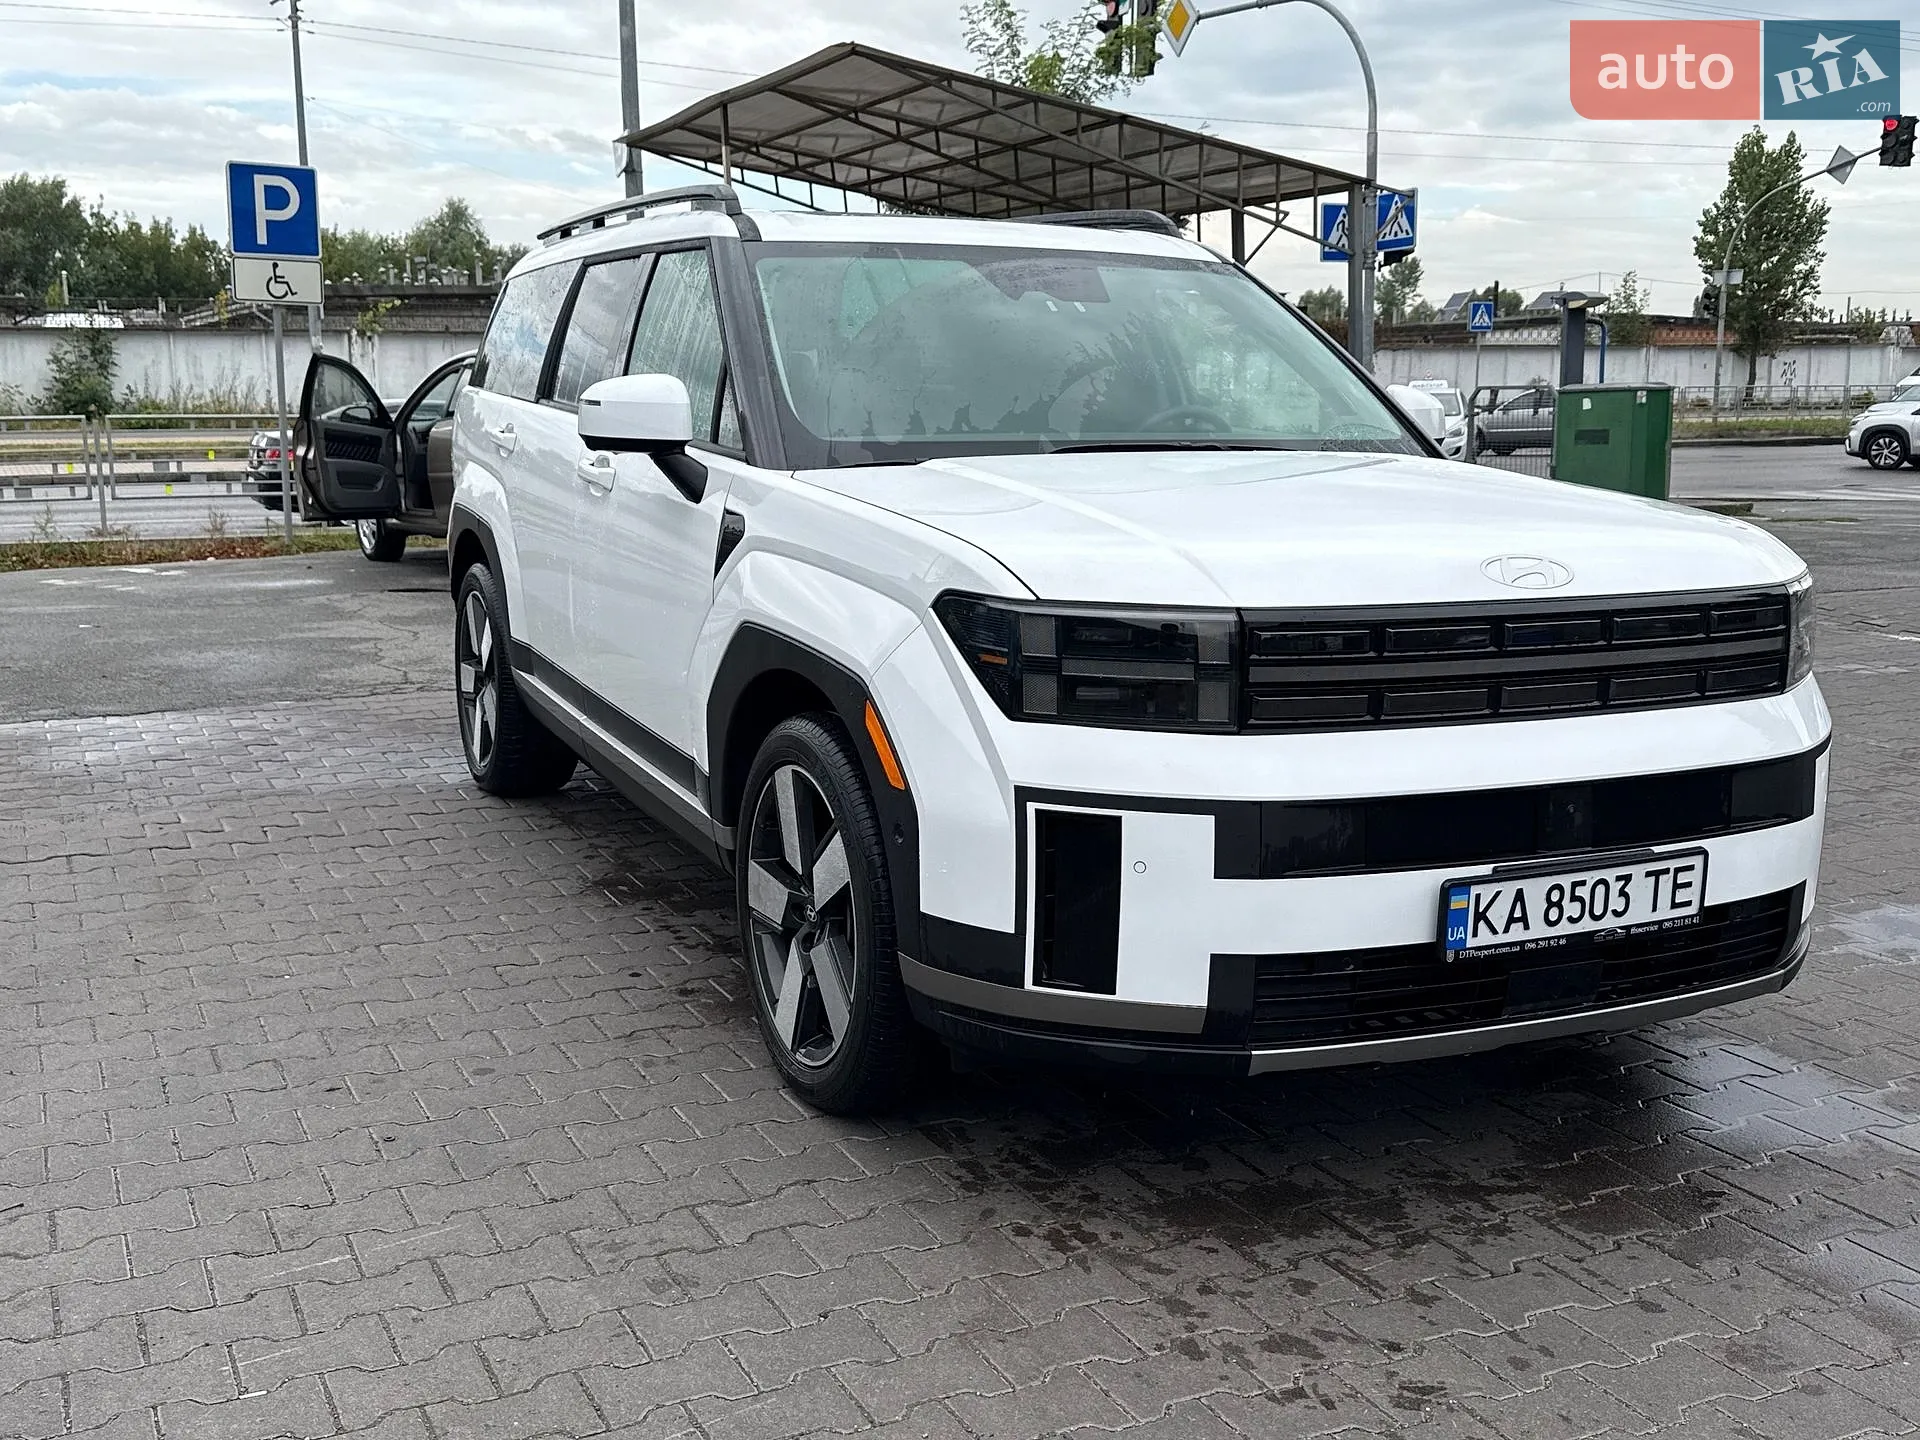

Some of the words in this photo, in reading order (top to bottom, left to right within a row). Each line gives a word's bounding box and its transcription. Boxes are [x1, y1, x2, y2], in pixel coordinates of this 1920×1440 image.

[253, 174, 301, 246] P
[1471, 887, 1531, 938] KA
[1543, 873, 1633, 928] 8503
[1644, 864, 1696, 913] TE
[1448, 926, 1466, 941] UA
[1459, 945, 1520, 959] DTPexpert.com.ua
